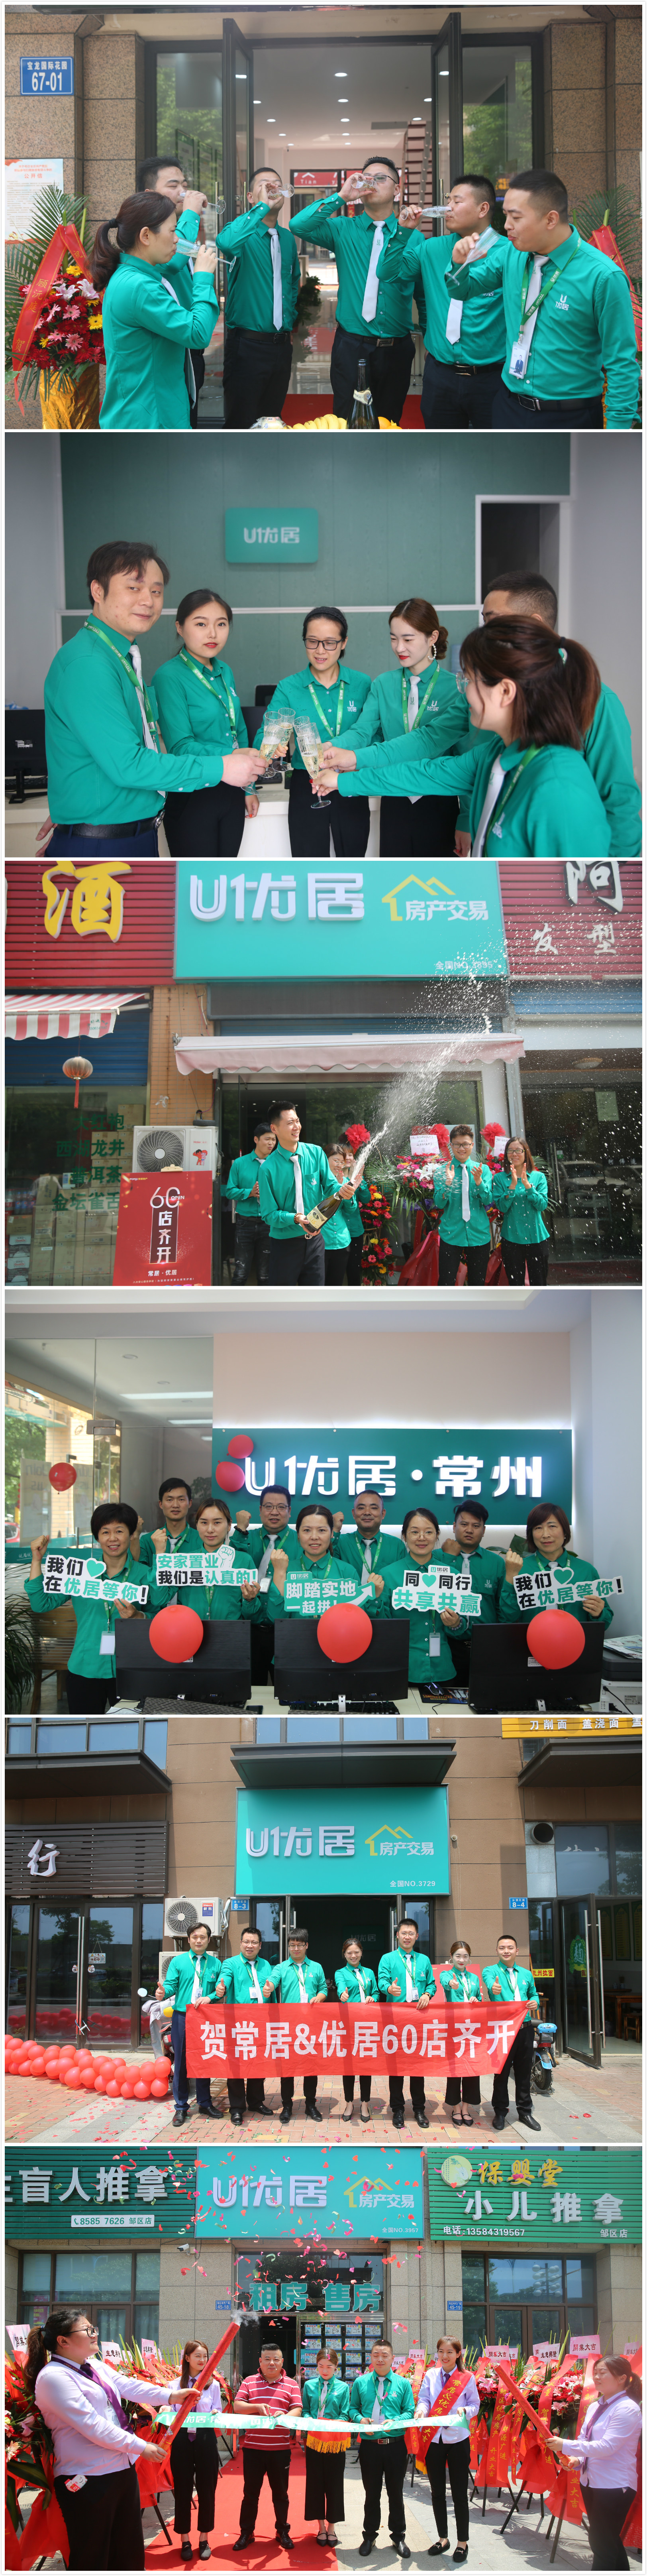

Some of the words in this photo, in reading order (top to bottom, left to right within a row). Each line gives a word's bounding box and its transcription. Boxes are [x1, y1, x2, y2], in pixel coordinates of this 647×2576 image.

[27, 61, 67, 70] 宝龙国际花园
[32, 72, 62, 91] 67-01
[555, 301, 569, 311] 优居
[14, 338, 25, 352] 贺
[42, 861, 133, 943] 酒
[406, 900, 489, 921] 房产交易
[533, 922, 617, 956] 发型
[435, 961, 493, 970] 全国NO.3895
[73, 1113, 125, 1131] 大红袍
[56, 1139, 125, 1157] 西湖龙井
[71, 1165, 123, 1184] 普洱茶
[52, 1192, 120, 1211] 金坛雀舌
[157, 1210, 173, 1263] 店齐开
[47, 1557, 84, 1576] 我们
[158, 1554, 219, 1569] 安家置业
[158, 1570, 257, 1584] 我们是认真的!
[405, 1572, 420, 1587] 同
[439, 1575, 471, 1590] 同行
[515, 1573, 552, 1592] 我们
[45, 1575, 146, 1602] 在优居等你!
[286, 1580, 356, 1599] 脚踏实地
[518, 1579, 622, 1609] 在优居等你!
[394, 1589, 480, 1614] 共享共赢
[530, 1719, 567, 1731] 刀削面
[582, 1718, 619, 1730] 盖浇面
[27, 1839, 61, 1877] 行
[380, 1841, 434, 1856] 房产交易
[200, 2019, 515, 2061] 贺常居&优居60店齐开
[477, 2158, 563, 2188] 保婴堂
[359, 2194, 415, 2209] 房产交易
[464, 2190, 624, 2226] 小儿推拿
[80, 2217, 100, 2226] 8585
[104, 2217, 125, 2226] 7626
[129, 2216, 153, 2226] 邹区店
[600, 2229, 628, 2239] 邹区店
[249, 2281, 309, 2311] 租房
[322, 2282, 381, 2312] 售房
[106, 2350, 121, 2358] 生意興隆
[572, 2343, 596, 2352] 開業大吉
[499, 2425, 509, 2460] 财源广进
[488, 2447, 497, 2477] 开业大吉
